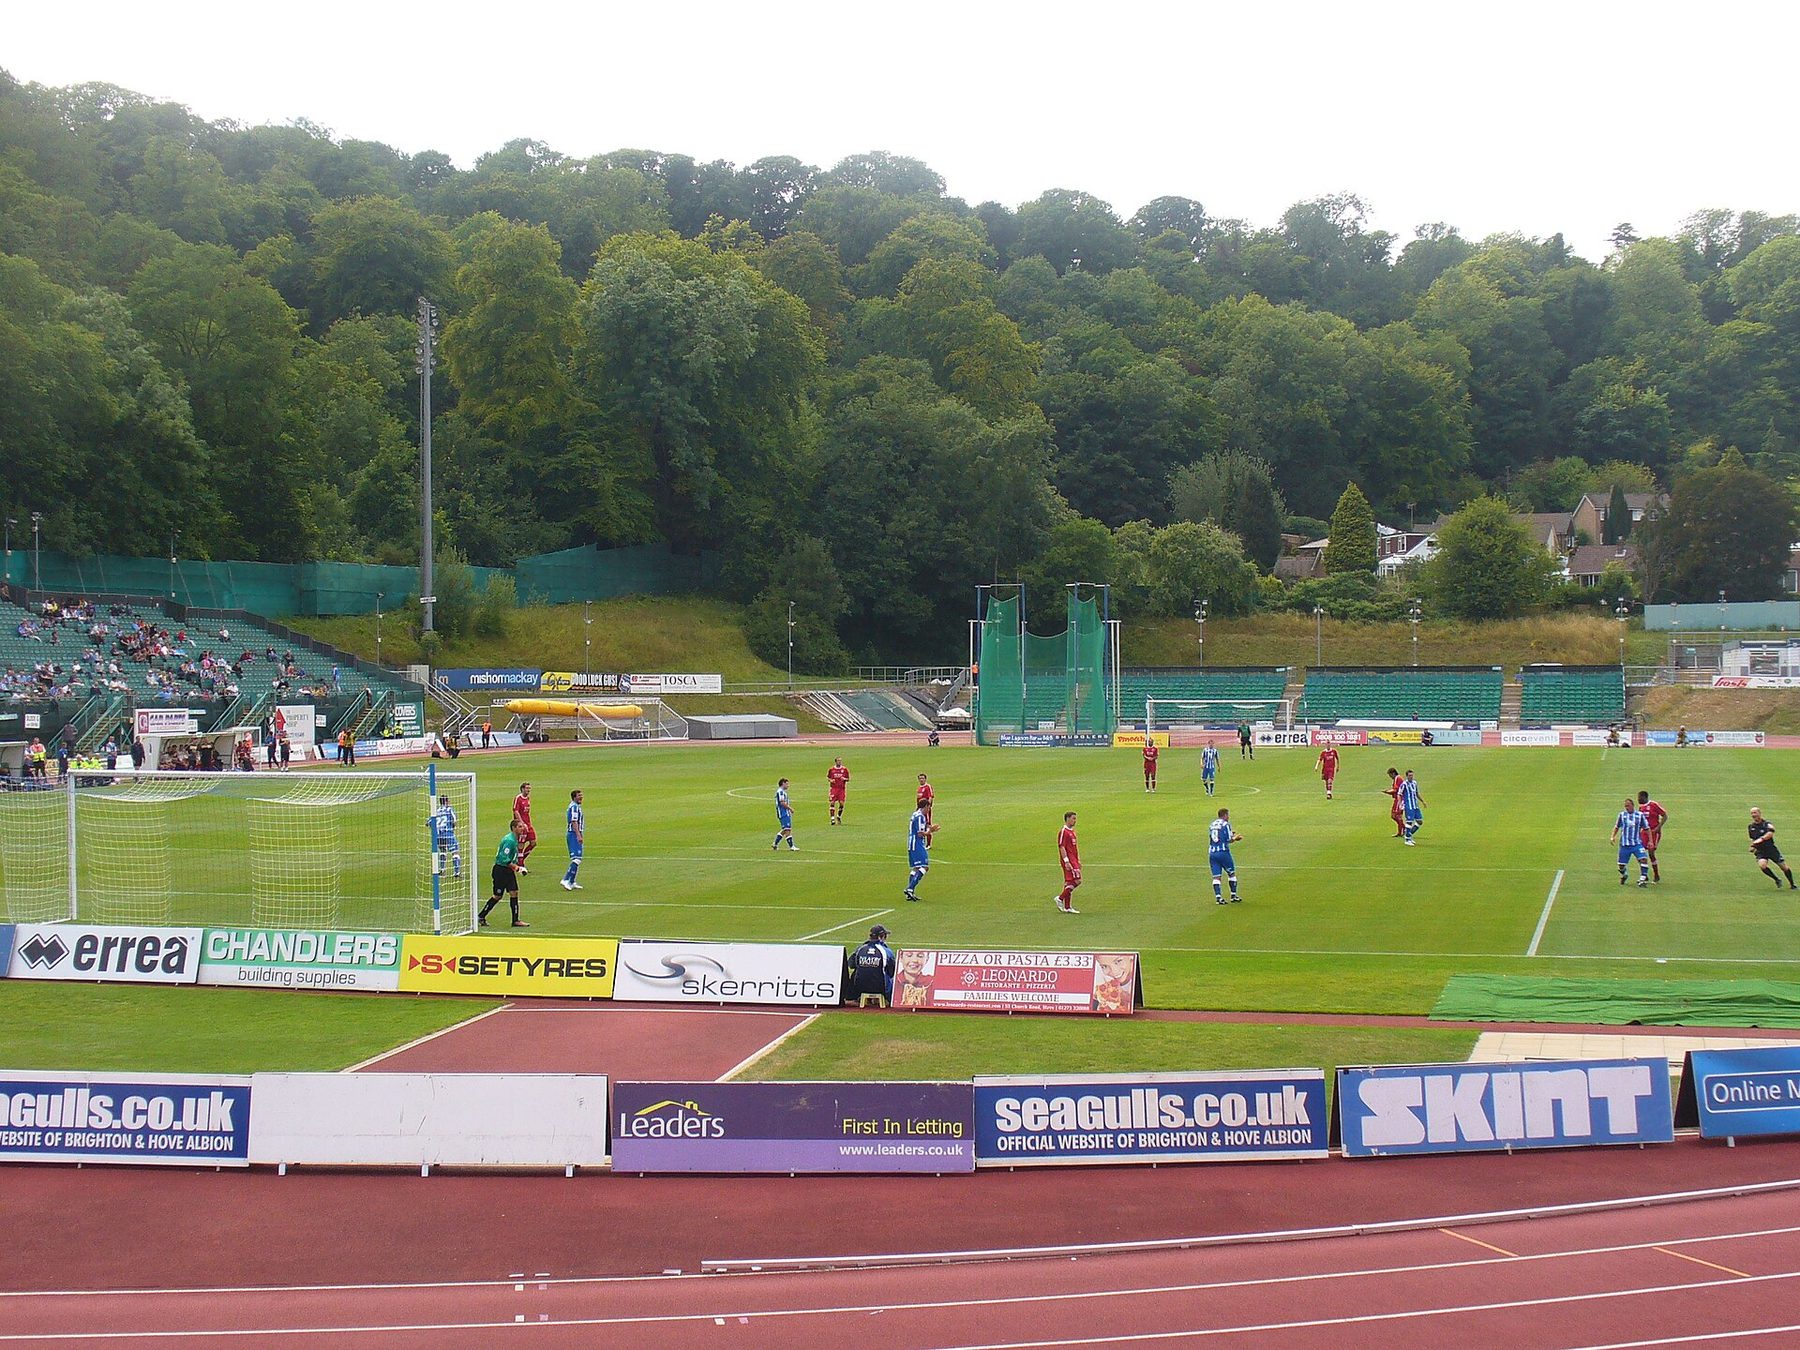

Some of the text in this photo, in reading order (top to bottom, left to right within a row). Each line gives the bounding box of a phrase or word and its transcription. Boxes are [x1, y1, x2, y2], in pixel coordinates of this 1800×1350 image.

[470, 672, 538, 685] mishonmackay
[587, 674, 602, 686] LUCK
[663, 675, 697, 685] TOSCA
[395, 706, 416, 717] COVERS
[1503, 733, 1558, 742] circaevents
[206, 930, 399, 966] CHANDLERS
[458, 955, 607, 979] SETYRES
[939, 953, 980, 965] PIZZA
[983, 954, 1002, 965] OR
[1007, 954, 1050, 966] PASTA
[238, 966, 356, 987] building supplies
[981, 969, 1058, 983] LEONARDO
[681, 973, 836, 999] skerritts
[963, 992, 1060, 1002] FAMILIES WELCOME
[1712, 1080, 1782, 1104] Online
[620, 1110, 725, 1138] Leaders
[842, 1118, 963, 1138] First In Letting
[44, 1132, 62, 1147] OF
[64, 1133, 132, 1149] BRIGHTON
[135, 1135, 145, 1149] &
[148, 1135, 183, 1150] HOVE
[185, 1135, 234, 1152] ALBION
[997, 1129, 1312, 1151] OFFICIAL WEBSITE OF BRIGHTON & HOVE ALBION
[839, 1143, 964, 1157] www.leaders.co.uk
